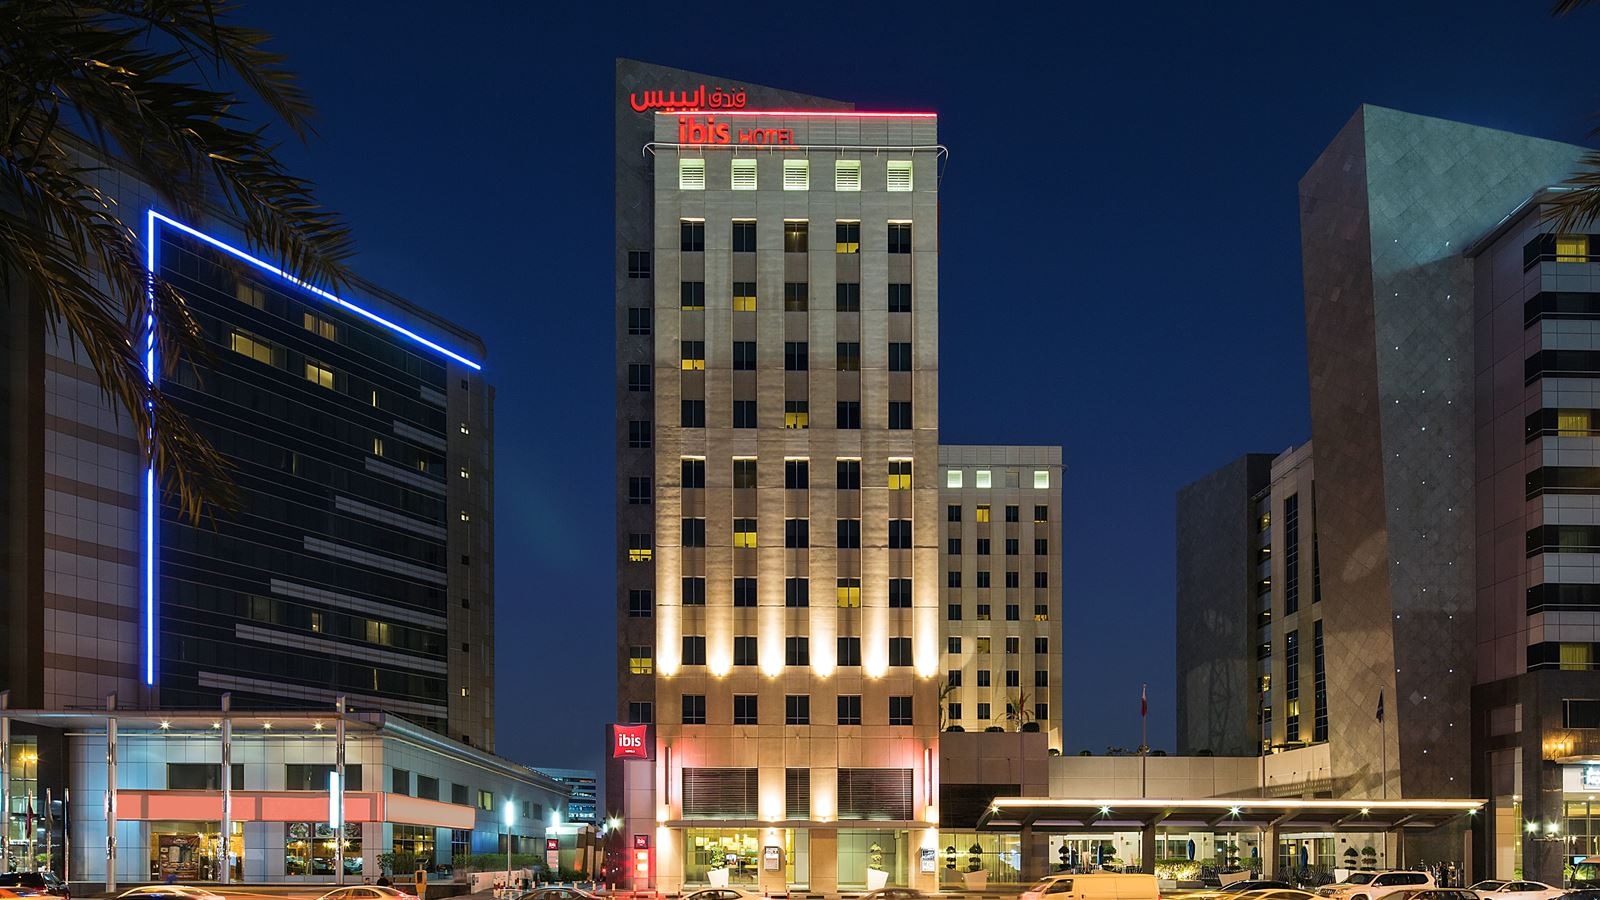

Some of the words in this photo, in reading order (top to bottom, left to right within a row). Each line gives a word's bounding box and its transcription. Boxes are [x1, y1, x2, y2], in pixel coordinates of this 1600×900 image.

[630, 85, 705, 113] ايبيس
[708, 87, 746, 108] فندق
[679, 114, 730, 144] ibis
[739, 128, 794, 144] HOTEL
[619, 733, 641, 747] ibis
